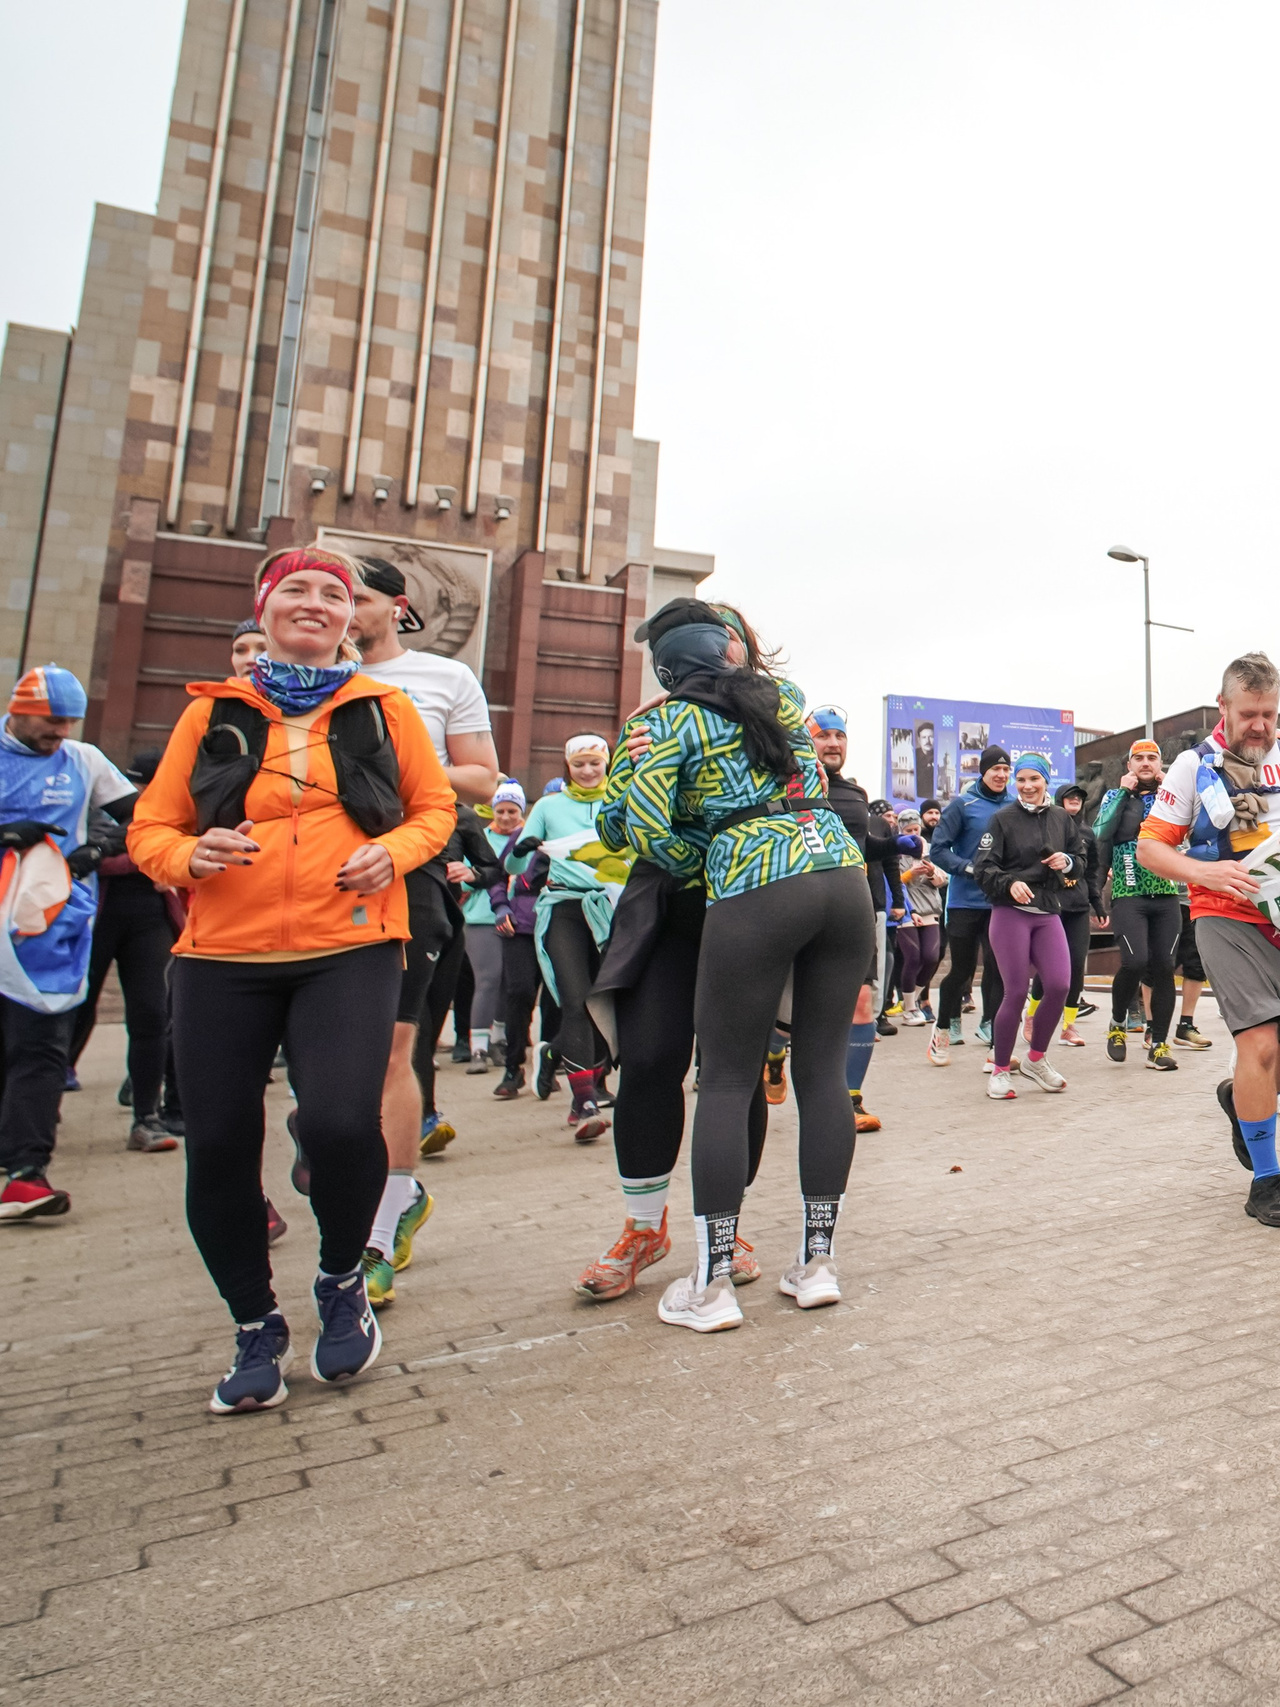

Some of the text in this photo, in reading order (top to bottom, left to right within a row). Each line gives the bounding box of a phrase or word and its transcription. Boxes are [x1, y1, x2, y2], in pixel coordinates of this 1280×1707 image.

[1124, 855, 1136, 886] RRRUN!
[810, 1203, 831, 1211] РАН
[811, 1211, 832, 1220] КРЯ
[715, 1217, 736, 1229] РАН
[807, 1219, 835, 1228] CREW
[715, 1226, 735, 1237] ЭНД
[715, 1235, 735, 1245] КРЯ
